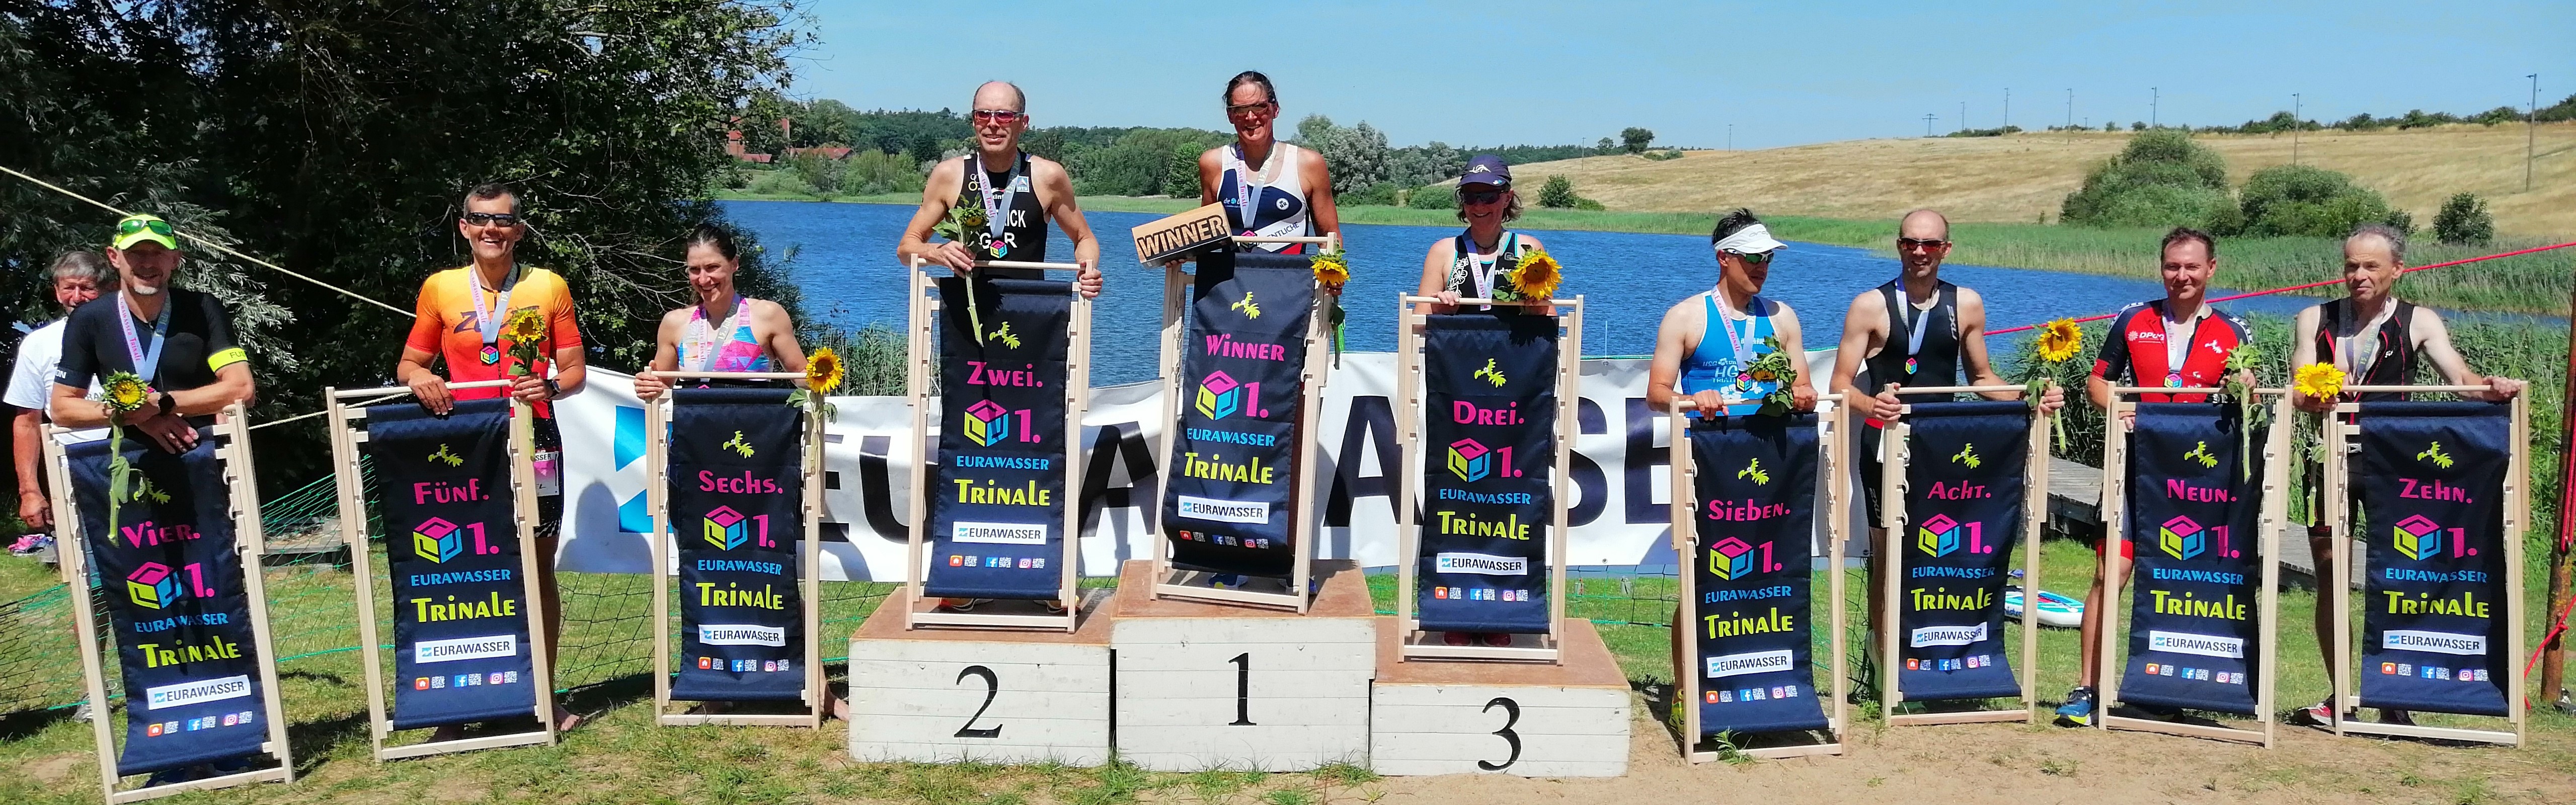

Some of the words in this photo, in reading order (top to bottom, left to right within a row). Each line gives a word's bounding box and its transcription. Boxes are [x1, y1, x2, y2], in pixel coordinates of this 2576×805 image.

[980, 232, 1018, 249] GR
[1137, 215, 1227, 259] WINNER
[1206, 334, 1284, 361] Winner
[967, 361, 1043, 387] Zwei.
[1715, 365, 1739, 377] HG
[1244, 382, 1269, 418] 1.
[1454, 400, 1524, 425] Drei.
[1014, 409, 1040, 443] 1.
[1187, 428, 1275, 447] EURAWASSER
[957, 456, 1049, 470] EURAWASSER
[1498, 446, 1522, 478] 1.
[414, 478, 489, 505] Fünf.
[699, 470, 783, 494] Sechs.
[1927, 480, 1991, 500] Acht.
[2167, 479, 2237, 502] Neun.
[2399, 478, 2472, 504] Zehn.
[1440, 489, 1531, 505] EURAWASSER
[1193, 503, 1263, 518] EURAWASSER
[1708, 499, 1791, 521] Sieben.
[121, 521, 200, 549] Vier.
[467, 522, 499, 555] 1.
[753, 515, 775, 548] 1.
[969, 528, 1041, 539] EURAWASSER
[1966, 521, 1992, 554] 1.
[2212, 525, 2240, 558] 1.
[2448, 527, 2477, 558] 1.
[698, 559, 782, 575] EURAWASSER
[1452, 558, 1522, 571] EURAWASSER
[1759, 540, 1782, 574] 1.
[184, 562, 214, 598] 1.
[411, 569, 511, 586] EURAWASSER
[1912, 567, 1995, 579] EURAWASSER
[2153, 568, 2244, 585] EURAWASSER
[2386, 568, 2487, 583] EURAWASSER
[1705, 586, 1791, 603] EURAWASSER
[136, 613, 228, 632] EURAWASSER
[713, 630, 779, 642] EURAWASSER
[1924, 628, 1982, 642] EURAWASSER
[2166, 637, 2237, 653] EURAWASSER
[2401, 635, 2480, 650] EURAWASSER
[434, 641, 510, 657] EURAWASSER
[1721, 656, 1787, 671] EURAWASSER
[167, 681, 245, 701] EURAWASSER
[1228, 653, 1257, 726] 1
[954, 665, 1003, 738] 2
[1478, 697, 1521, 771] 3
